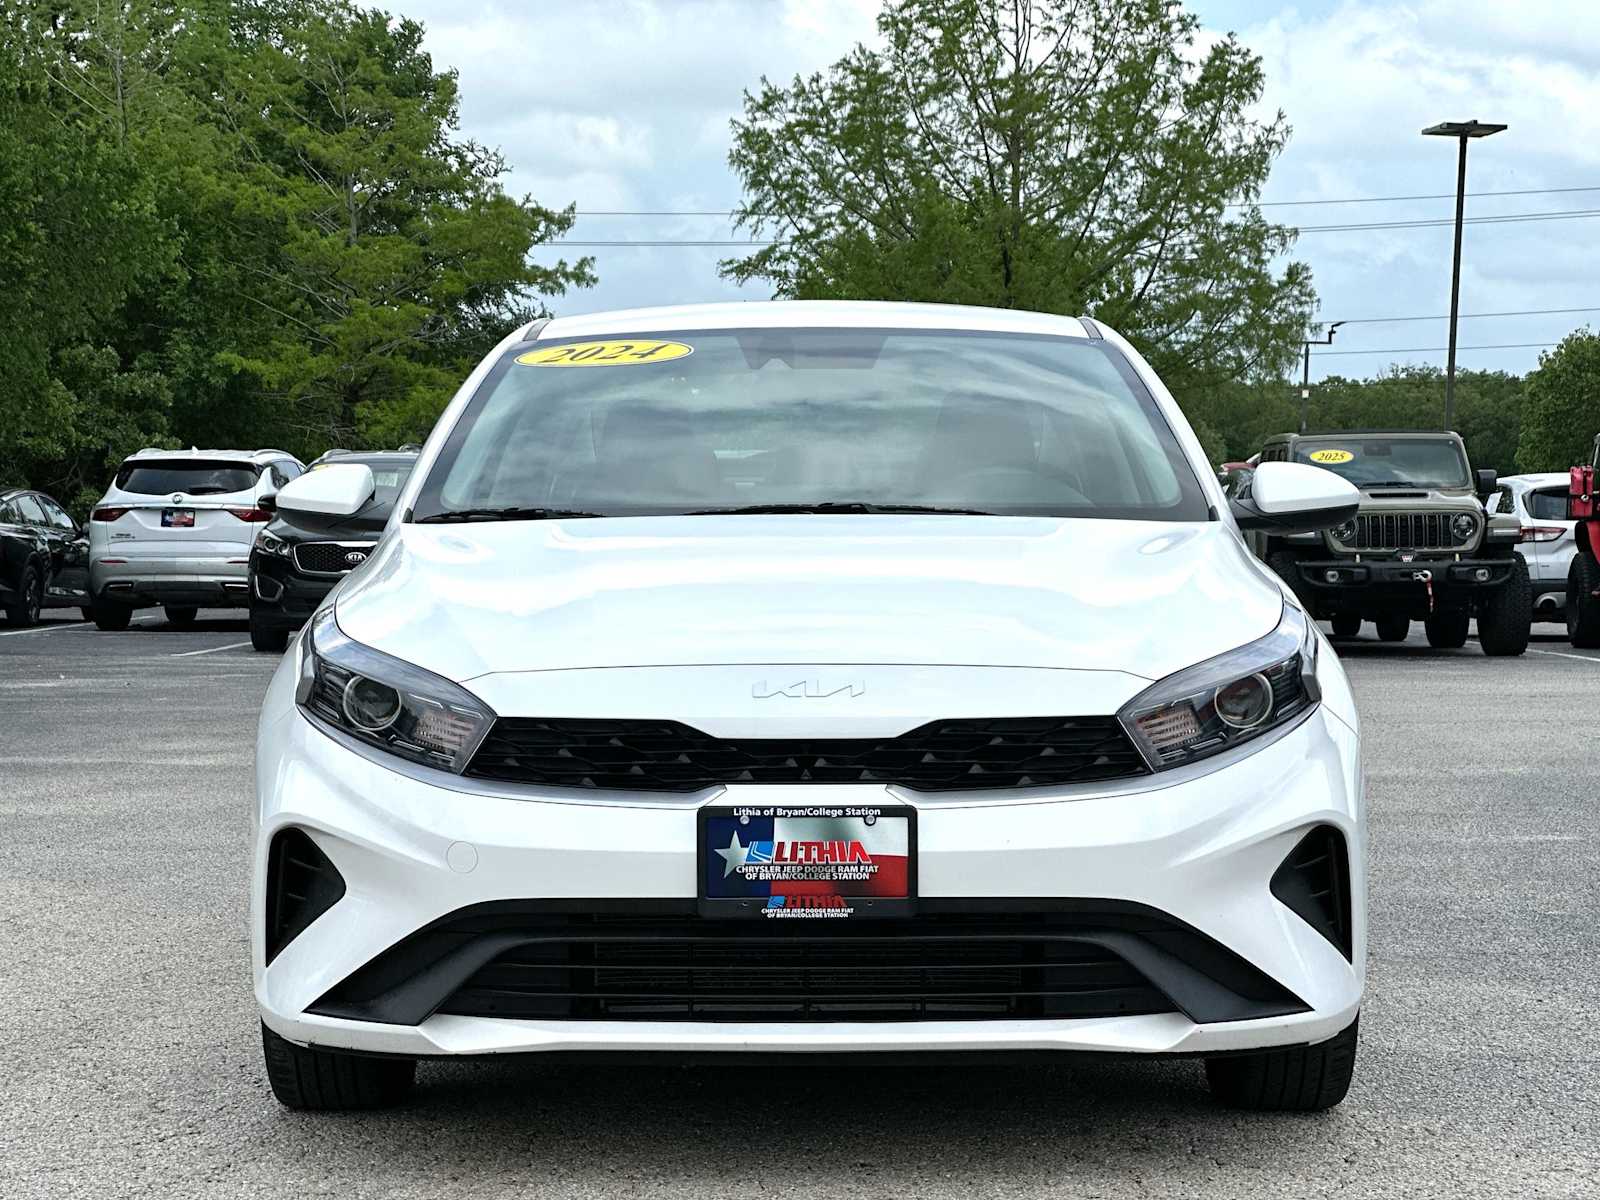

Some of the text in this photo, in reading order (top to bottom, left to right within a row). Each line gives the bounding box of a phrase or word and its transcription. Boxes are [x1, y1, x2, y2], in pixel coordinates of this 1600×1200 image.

[537, 343, 671, 364] 2024
[1317, 452, 1346, 461] 2025
[733, 807, 881, 818] Lithia of Bryan/College Station
[774, 841, 872, 864] LITHIA
[736, 865, 879, 873] CHRYSLER JEEP DODGE RAM FIAT
[786, 895, 848, 908] LITHIA
